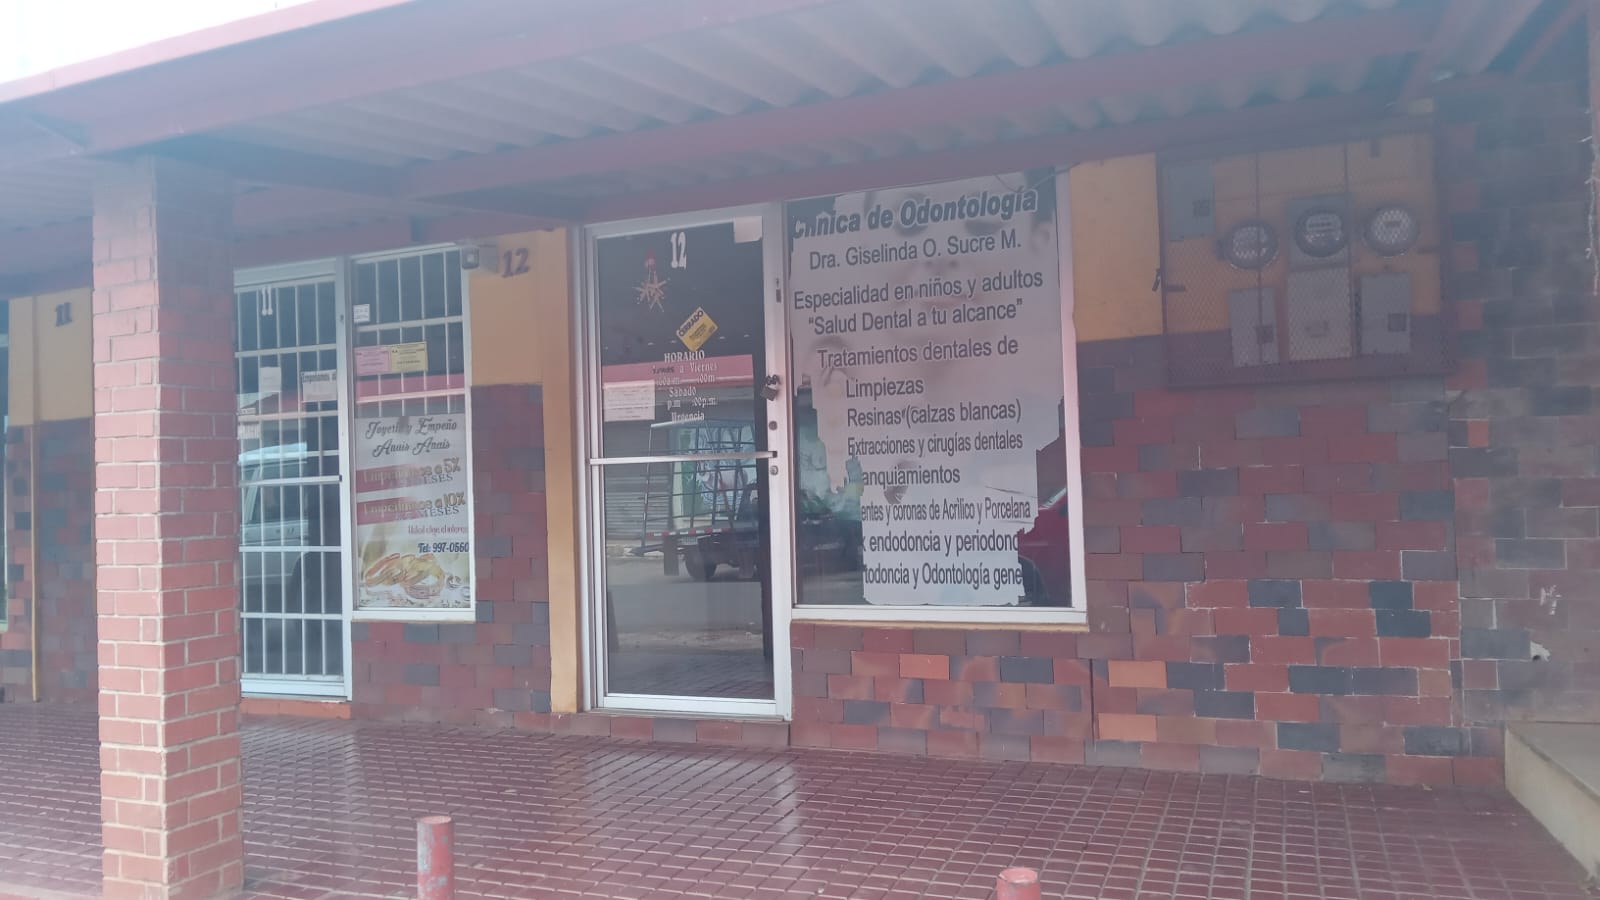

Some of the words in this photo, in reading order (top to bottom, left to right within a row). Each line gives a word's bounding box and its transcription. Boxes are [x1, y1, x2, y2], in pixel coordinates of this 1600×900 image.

[868, 205, 893, 230] de
[901, 186, 1037, 228] Odontología
[502, 248, 530, 278] 12
[671, 231, 687, 270] 12
[809, 251, 840, 270] Dra.
[846, 242, 918, 266] Giselinda
[923, 238, 941, 257] O.
[947, 235, 996, 256] Sucre
[1001, 229, 1022, 249] M.
[794, 282, 889, 312] Especialidad
[894, 286, 914, 300] en
[919, 278, 962, 299] niños
[967, 279, 977, 298] y
[982, 269, 1043, 292] adultos
[679, 311, 704, 337] CERRADO
[862, 309, 912, 331] Dental
[917, 312, 927, 327] a
[932, 307, 947, 325] tu
[663, 350, 705, 364] HORARIO
[817, 346, 918, 369] Tratamientos
[923, 338, 992, 361] dentales
[997, 335, 1019, 355] de
[845, 377, 925, 401] Limpiezas
[415, 416, 458, 435] Empeño
[847, 408, 901, 427] Resinas
[906, 404, 955, 428] (calzas
[960, 399, 1022, 424] blancas)
[847, 435, 916, 456] Extracciones
[917, 439, 925, 458] y
[927, 432, 971, 456] cirugías
[974, 429, 1024, 451] dentales
[443, 457, 461, 473] 5%
[862, 465, 961, 490] anquiamientos
[443, 492, 466, 508] 10%
[861, 502, 884, 521] entes
[885, 504, 892, 526] y
[893, 503, 927, 521] coronas
[929, 499, 940, 520] de
[977, 503, 983, 525] y
[984, 496, 1031, 520] Porcelana
[869, 530, 941, 552] endodoncia
[944, 534, 952, 557] y
[956, 529, 1019, 557] periodonc
[863, 563, 910, 584] todoncia
[913, 570, 920, 590] y
[921, 562, 990, 591] Odontología
[993, 567, 1023, 591] gene
